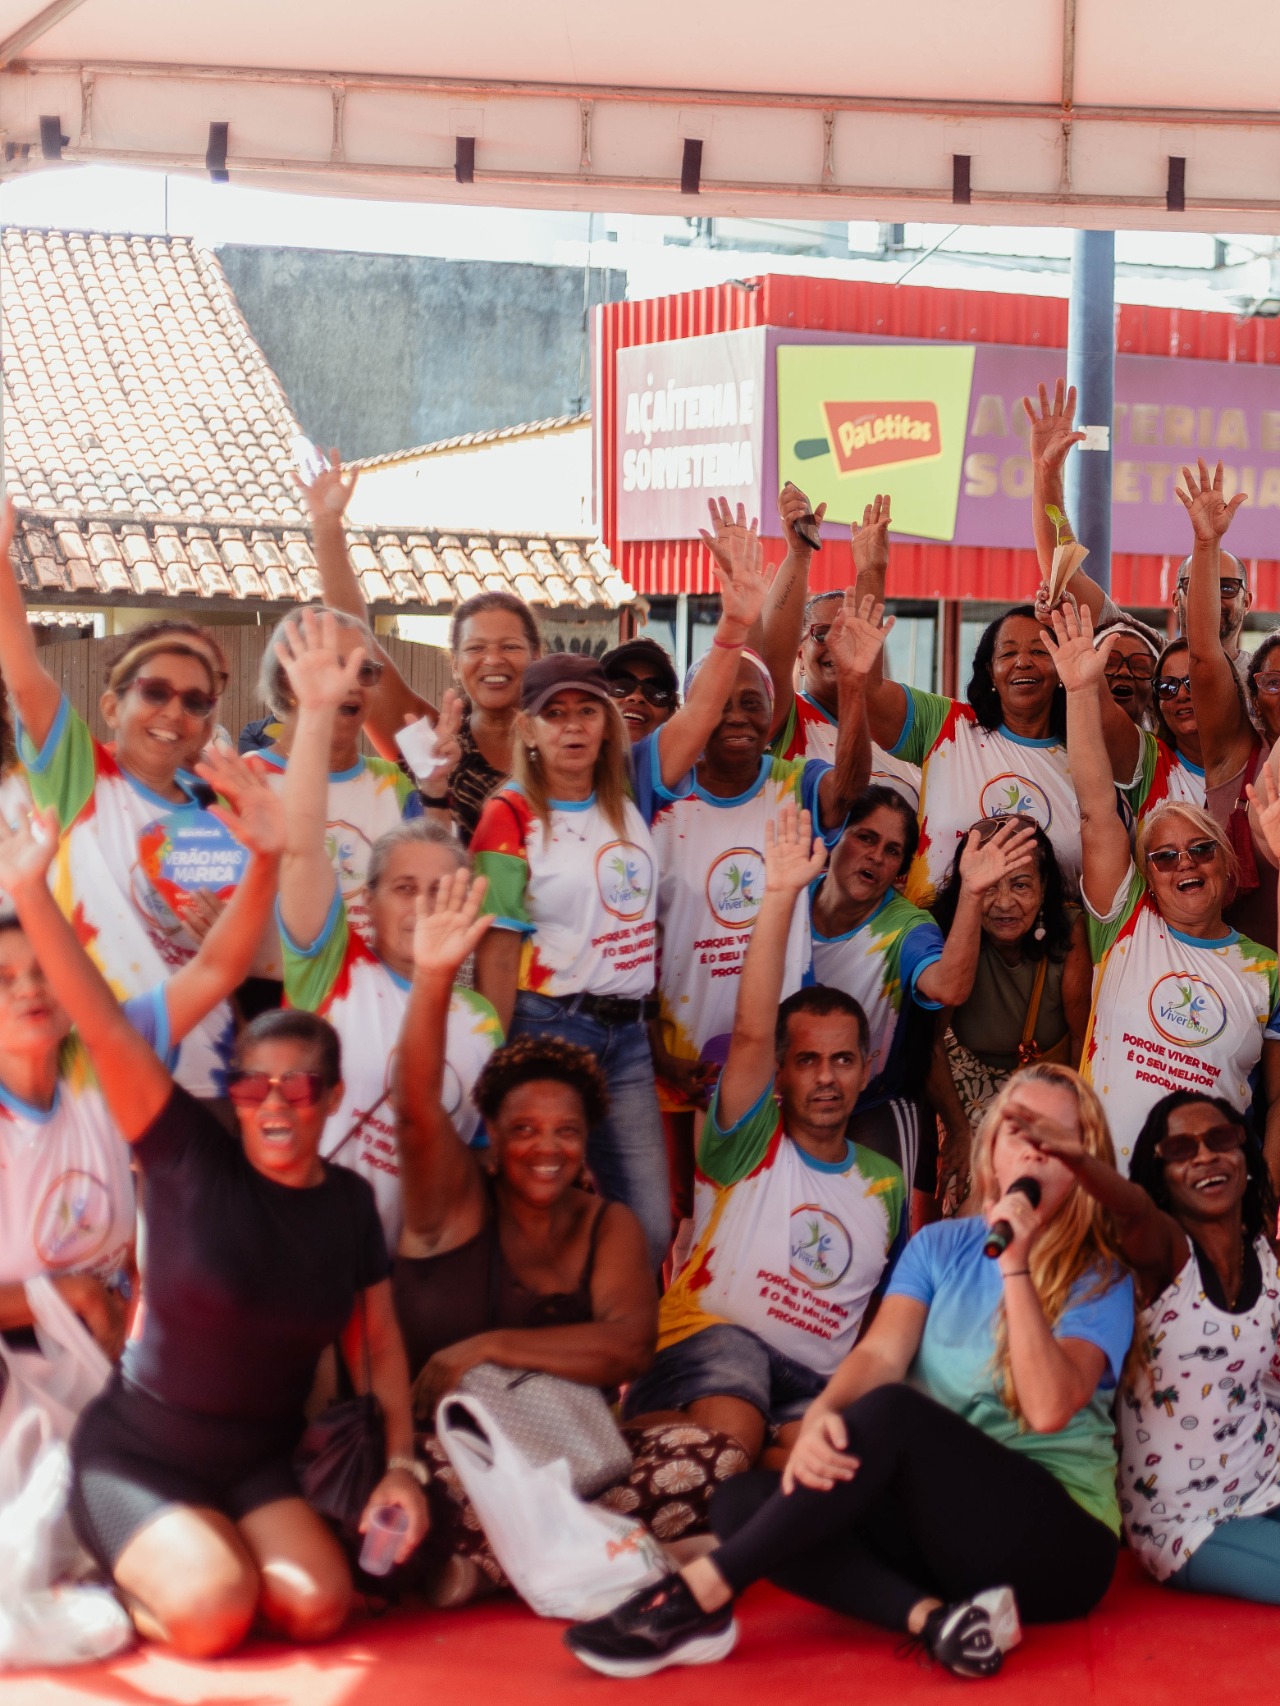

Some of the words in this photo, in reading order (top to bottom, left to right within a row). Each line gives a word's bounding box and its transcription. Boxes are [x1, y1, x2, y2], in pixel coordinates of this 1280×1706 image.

[738, 379, 754, 425] E
[623, 440, 754, 491] SORVETERIA
[165, 848, 208, 866] VERÃO
[211, 850, 242, 865] MAIS
[693, 936, 735, 950] PORQUE
[700, 952, 707, 964] É
[709, 954, 716, 963] O
[718, 951, 740, 962] SEU
[1122, 1032, 1167, 1056] PORQUE
[1168, 1049, 1201, 1068] VIVER
[1201, 1061, 1222, 1078] BEM
[1127, 1049, 1135, 1061] É
[1136, 1055, 1145, 1064] O
[1146, 1057, 1167, 1072] SEU
[1168, 1066, 1214, 1088] MELHOR
[770, 1292, 780, 1301] O
